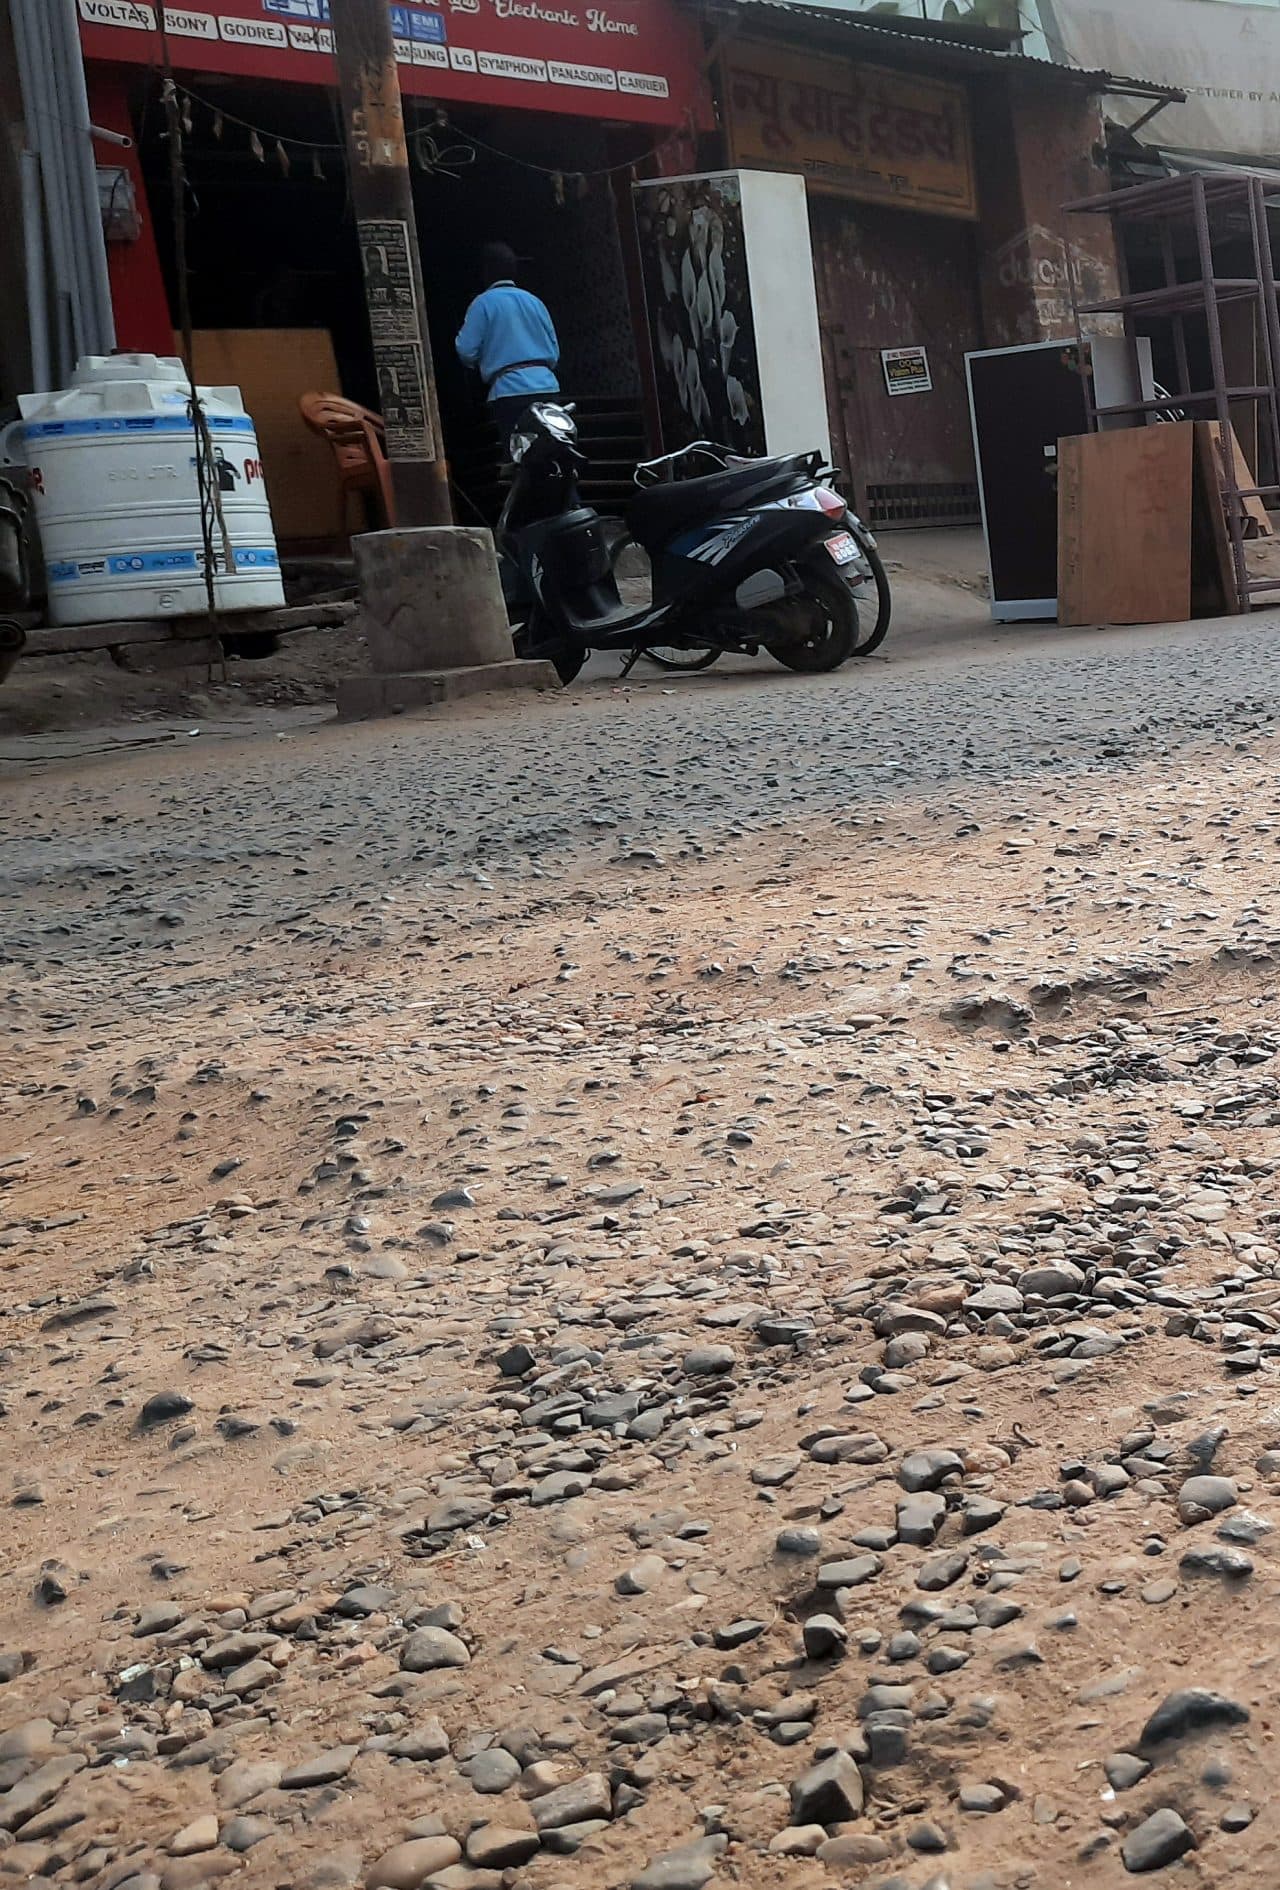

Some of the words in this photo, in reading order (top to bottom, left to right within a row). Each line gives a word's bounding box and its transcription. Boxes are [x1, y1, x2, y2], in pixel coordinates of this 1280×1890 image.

[411, 13, 439, 28] EMI
[587, 8, 639, 35] Home
[85, 2, 149, 24] VOLTAS
[166, 14, 208, 32] SONY
[224, 23, 284, 42] GODREJ
[455, 53, 472, 67] LG
[480, 57, 545, 77] SYMPHONY
[551, 66, 614, 86] PANASONIC
[620, 76, 667, 93] CARRIER
[1249, 92, 1263, 102] BY
